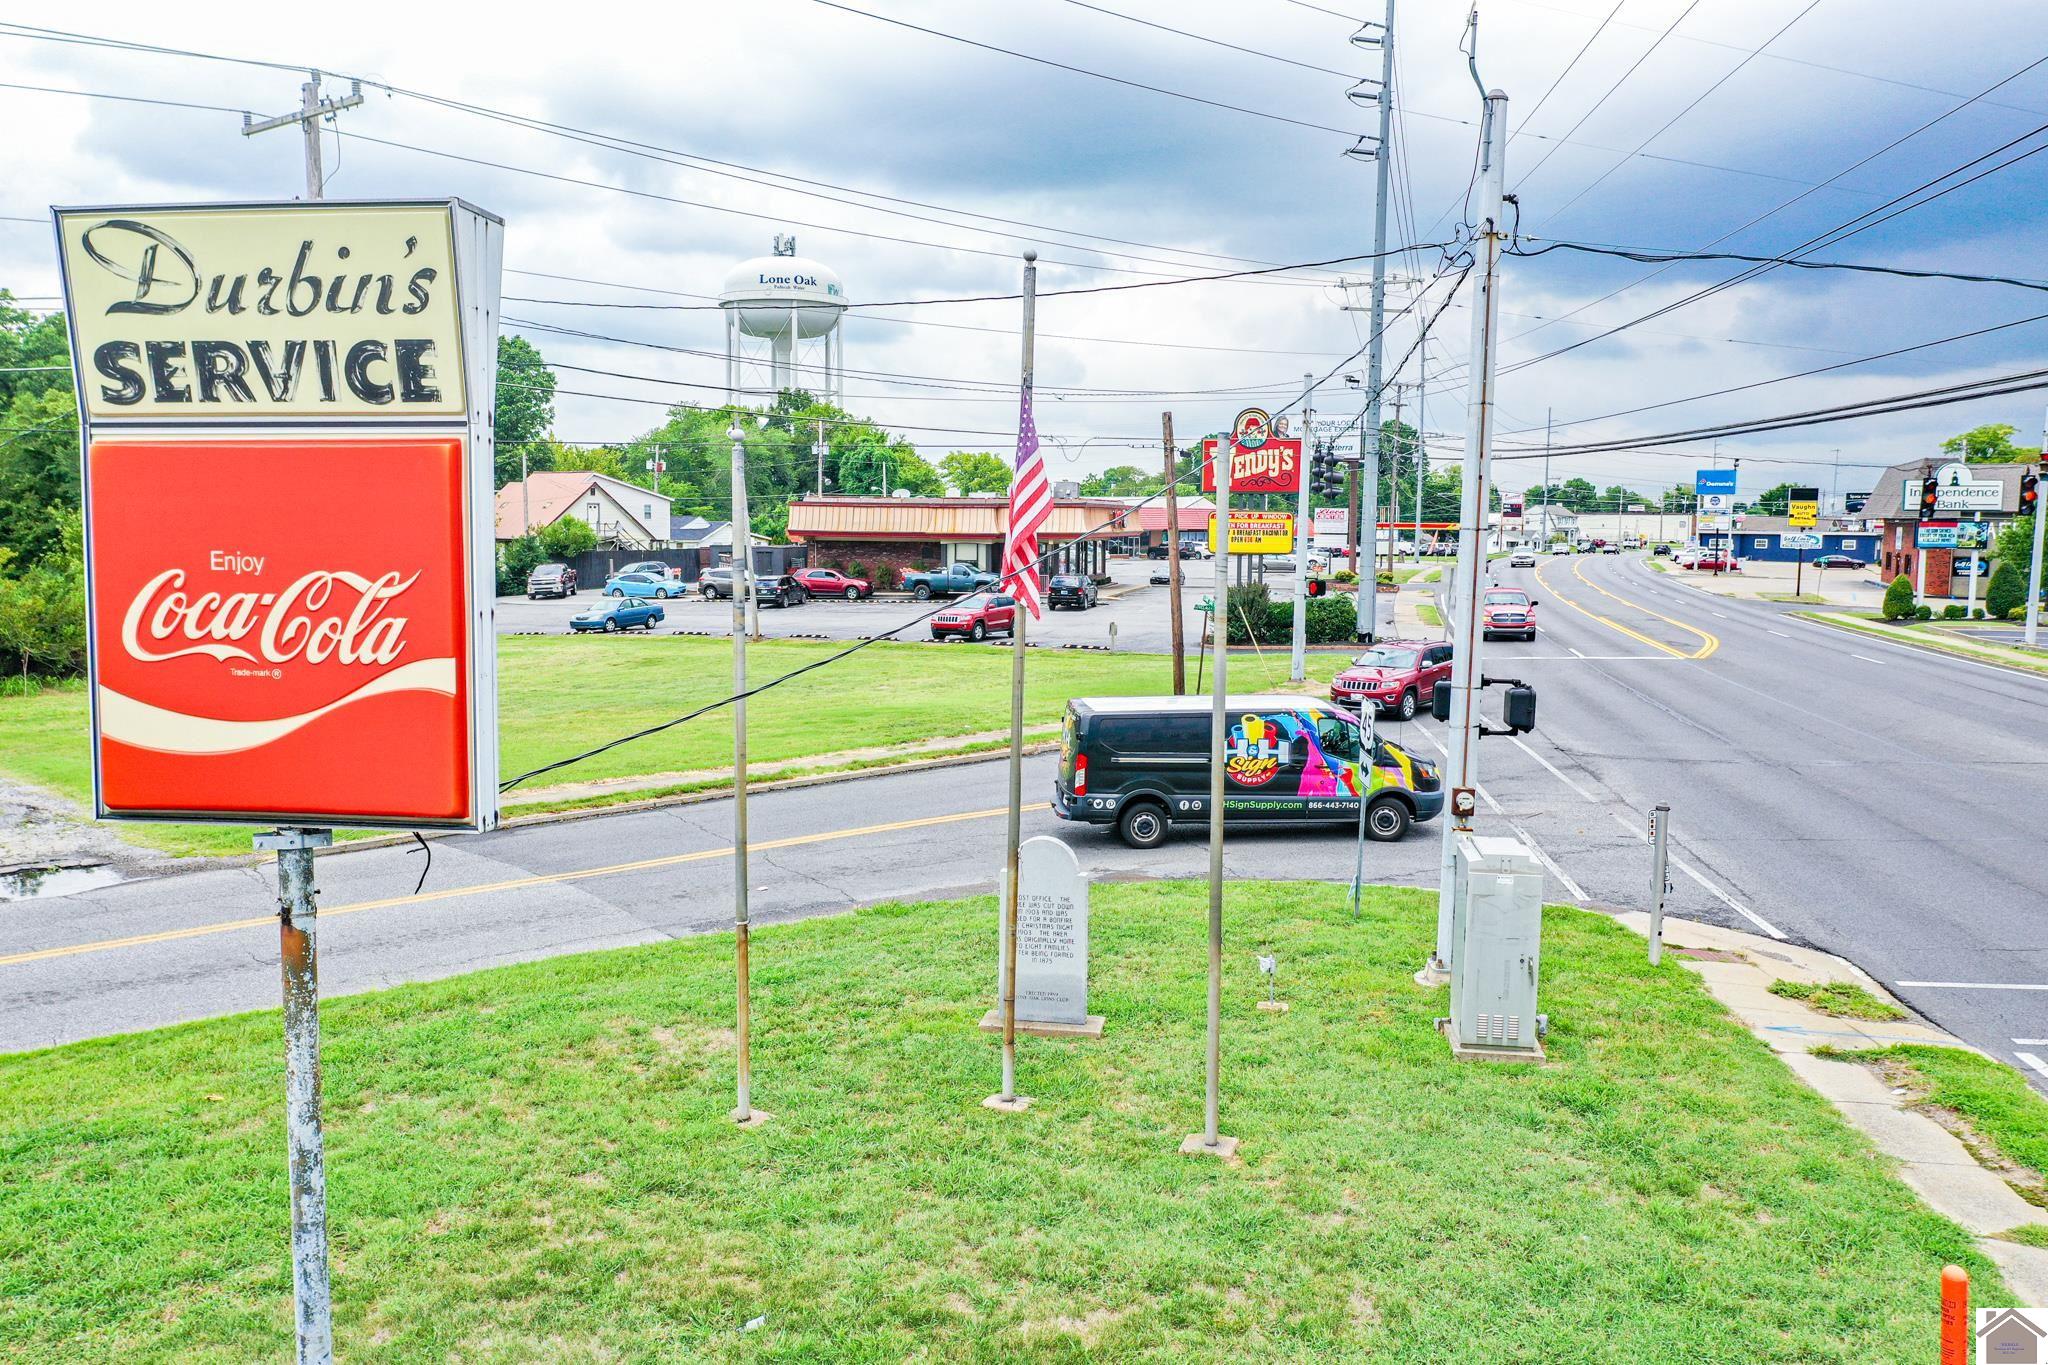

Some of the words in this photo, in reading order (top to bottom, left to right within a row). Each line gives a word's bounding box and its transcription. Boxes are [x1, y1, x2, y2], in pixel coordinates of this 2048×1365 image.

[82, 219, 438, 317] Durbin's
[759, 274, 791, 284] Lone
[794, 275, 817, 286] Oak
[94, 339, 443, 406] SERVICE
[1909, 488, 1999, 498] Inpendence
[1936, 500, 1969, 509] Bank
[210, 550, 265, 576] Enjoy
[121, 568, 423, 666] Coca-Cola
[1362, 714, 1372, 742] 45
[1226, 756, 1278, 777] Sign
[1236, 774, 1267, 783] SUPPLY
[1223, 800, 1303, 810] HSignSupply.com
[1308, 801, 1360, 809] 866-443-7140
[1021, 922, 1054, 930] CHRISTMAS
[1024, 936, 1057, 944] ORIGINALLY
[1050, 951, 1074, 959] FORMED
